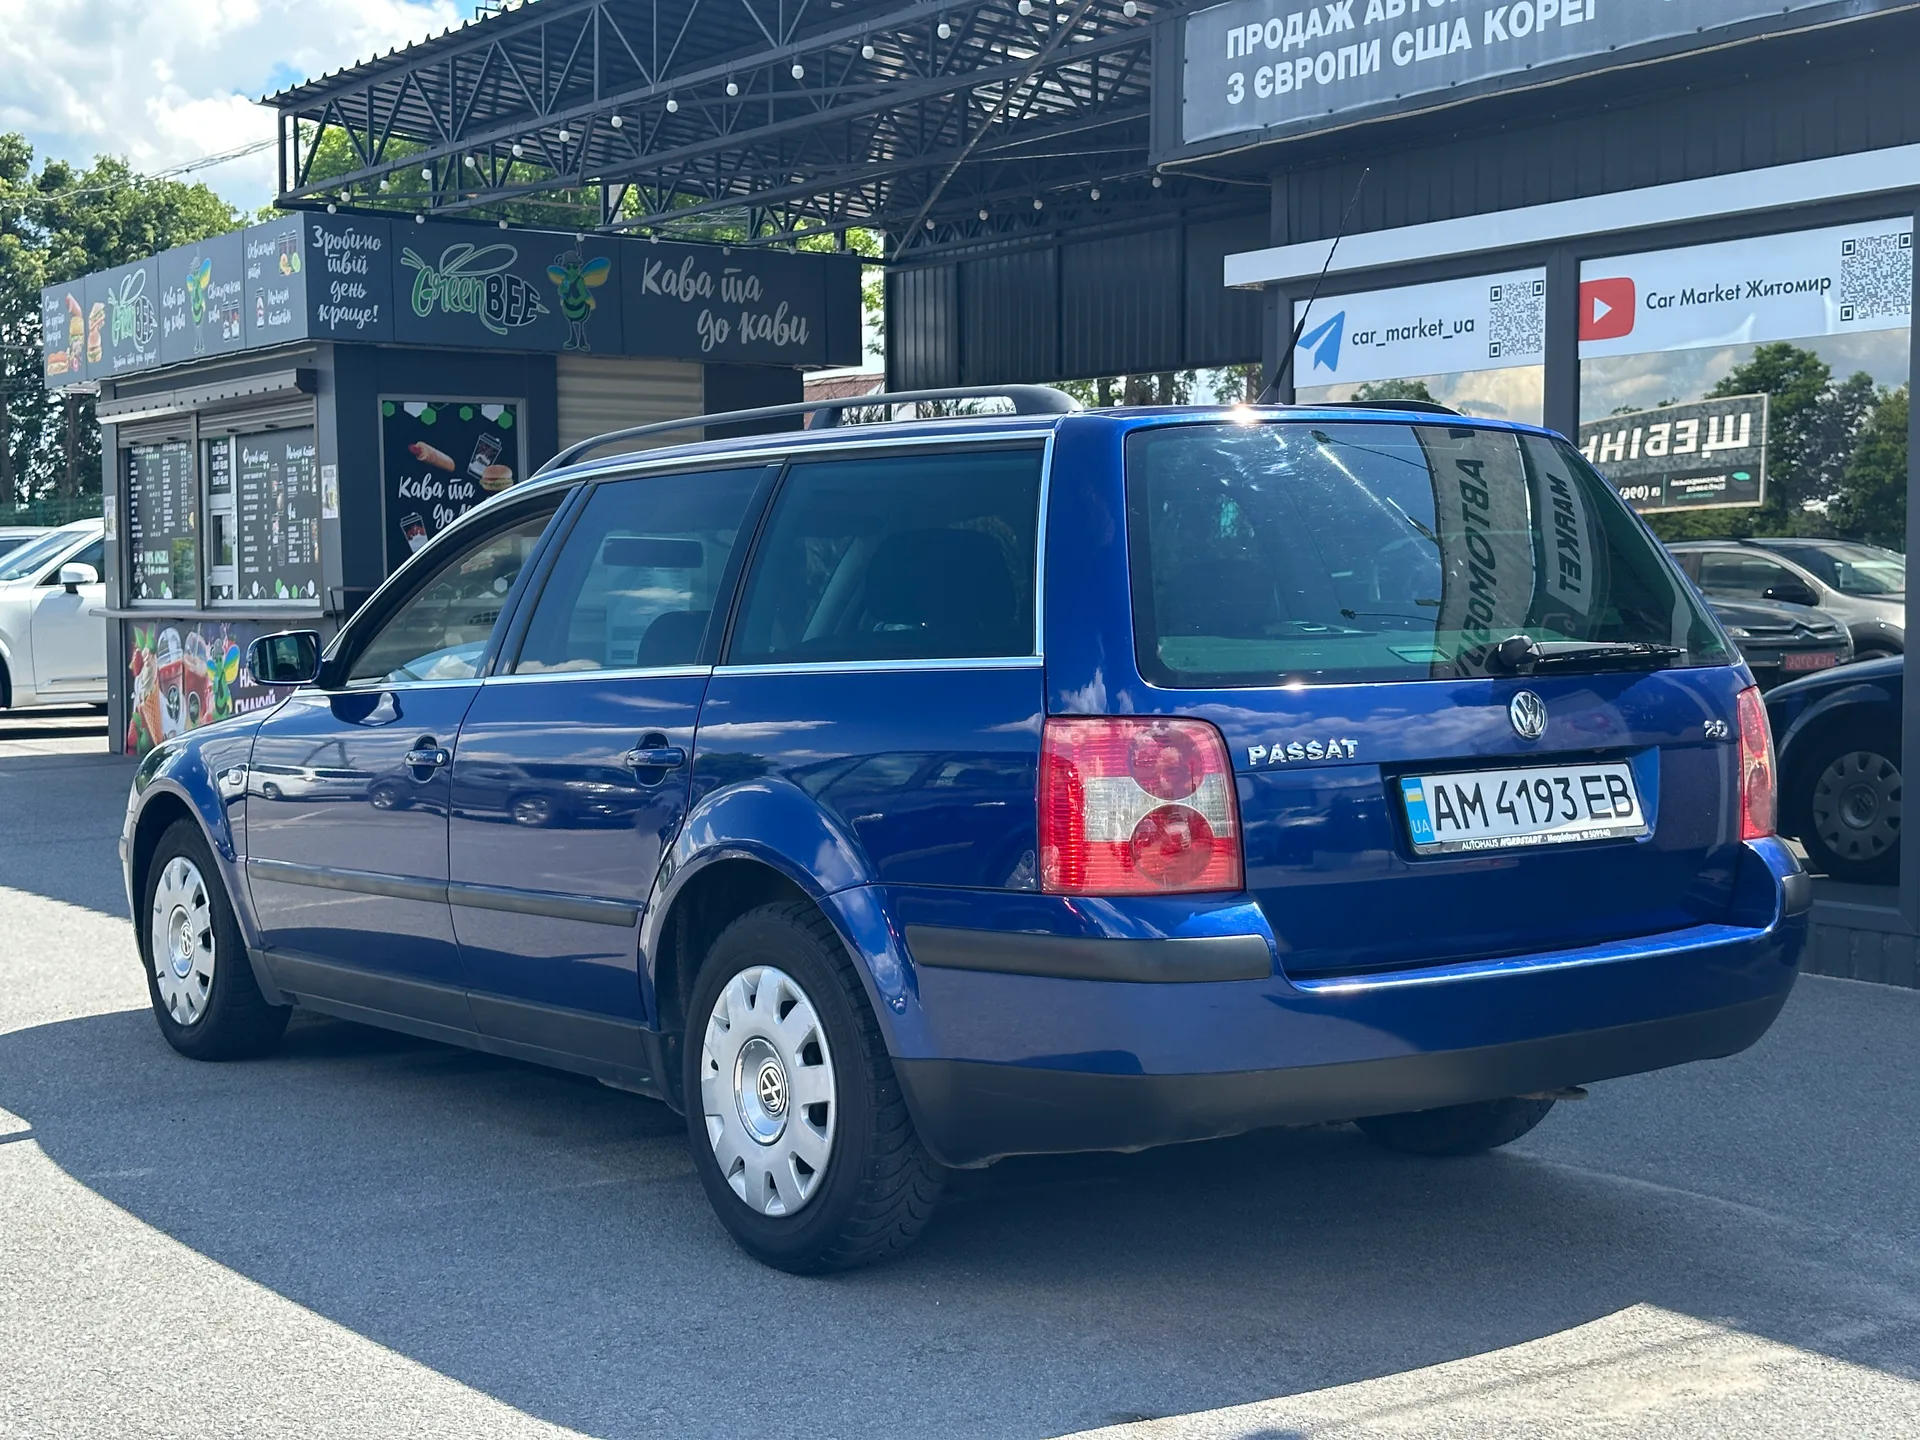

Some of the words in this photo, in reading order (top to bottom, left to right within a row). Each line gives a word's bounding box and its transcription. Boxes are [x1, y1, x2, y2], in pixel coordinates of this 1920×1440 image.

[1226, 1, 1355, 59] ПРОДАЖ
[1227, 73, 1245, 104] З
[1254, 39, 1380, 96] ЄВРОПИ
[1392, 17, 1472, 66] США
[312, 225, 382, 256] Зробимо
[327, 252, 369, 275] твій
[330, 280, 367, 303] день
[641, 255, 715, 302] Кава
[720, 267, 764, 304] та
[1646, 292, 1675, 309] Car
[1679, 284, 1741, 307] Market
[1745, 276, 1832, 299] Житомир
[317, 304, 379, 330] краще!
[696, 308, 732, 352] до
[737, 301, 810, 346] кави
[1351, 317, 1475, 347] car_market_ua
[398, 473, 445, 501] Кава
[447, 478, 476, 500] та
[432, 503, 455, 529] до
[1247, 738, 1359, 766] PASSAT
[1433, 782, 1490, 831] AM
[1496, 778, 1578, 826] 4193
[1580, 774, 1634, 820] EB
[1412, 819, 1431, 834] UA
